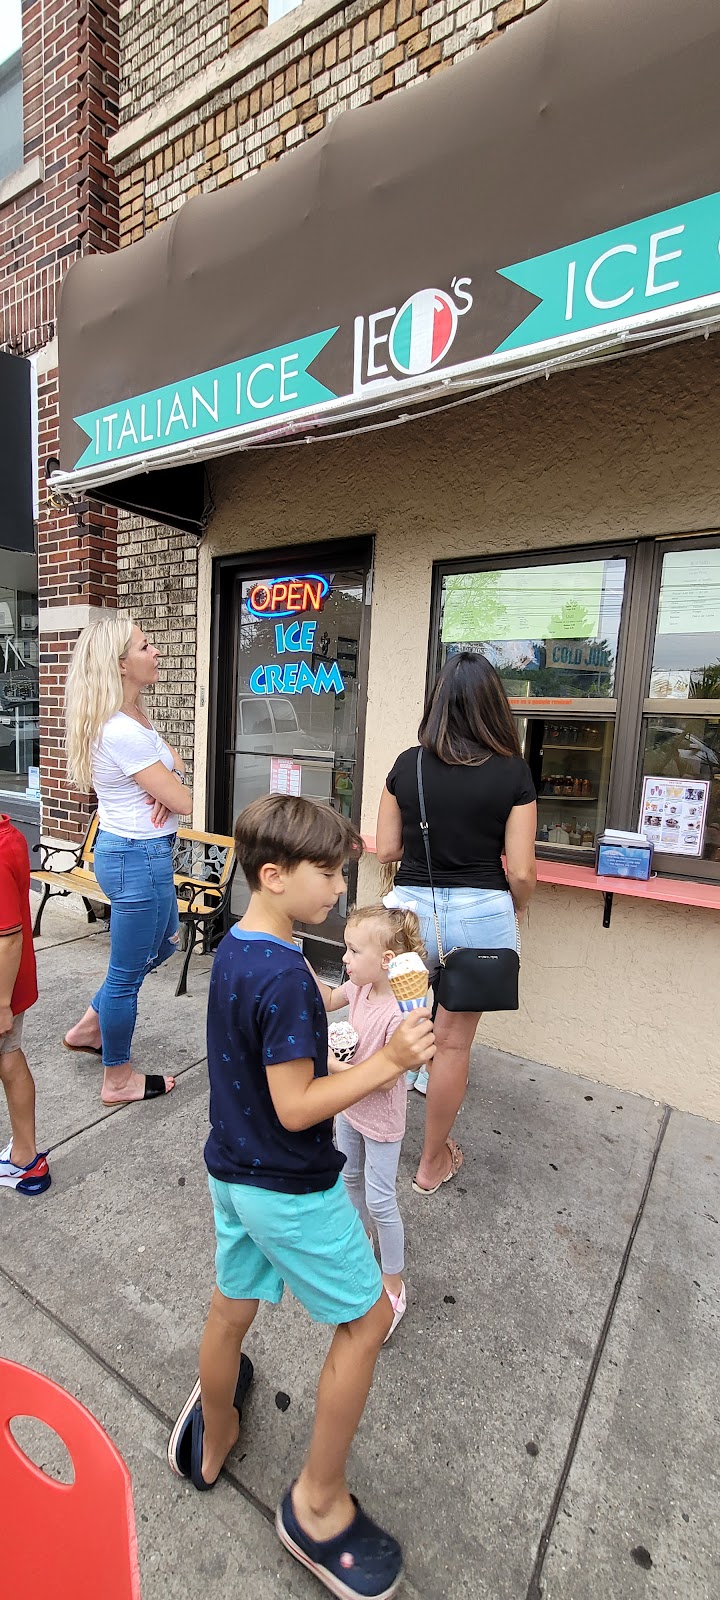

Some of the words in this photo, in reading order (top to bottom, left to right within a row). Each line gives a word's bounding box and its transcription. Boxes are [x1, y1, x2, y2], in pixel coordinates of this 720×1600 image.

[564, 224, 686, 321] ICE
[353, 276, 474, 393] LEO'S
[92, 383, 219, 456] ITALIAN
[234, 352, 302, 416] ICE
[250, 583, 323, 611] OPEN
[274, 620, 318, 653] ICE
[552, 645, 582, 665] COLD
[584, 647, 610, 667] JUIC
[249, 660, 345, 696] CREAM
